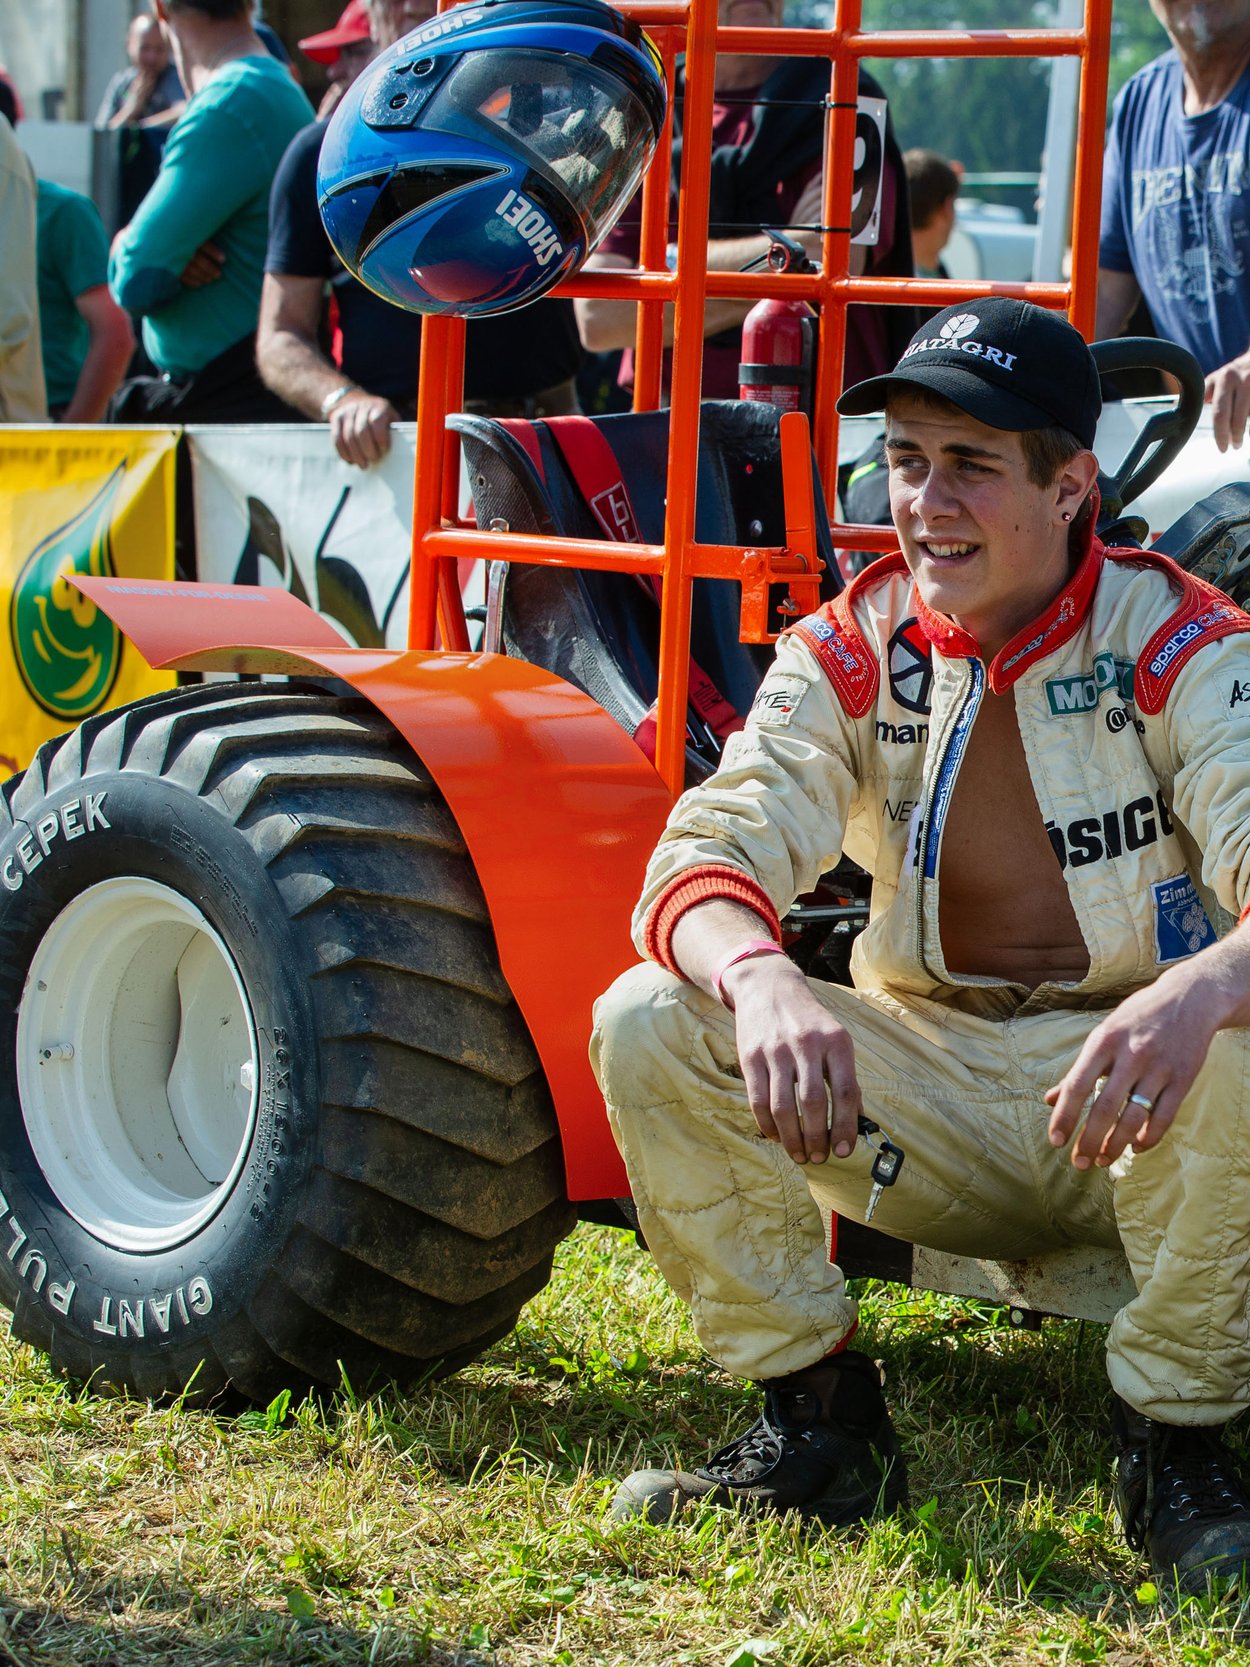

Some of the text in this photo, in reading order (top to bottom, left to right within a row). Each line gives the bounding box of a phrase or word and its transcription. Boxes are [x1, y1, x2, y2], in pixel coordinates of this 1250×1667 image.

[396, 7, 484, 57] SHOEI
[495, 189, 563, 267] SHOEI
[828, 637, 860, 673] CAFE
[1150, 623, 1202, 676] sparco
[3, 791, 112, 891] CEPEK
[93, 1276, 214, 1338] GIANT
